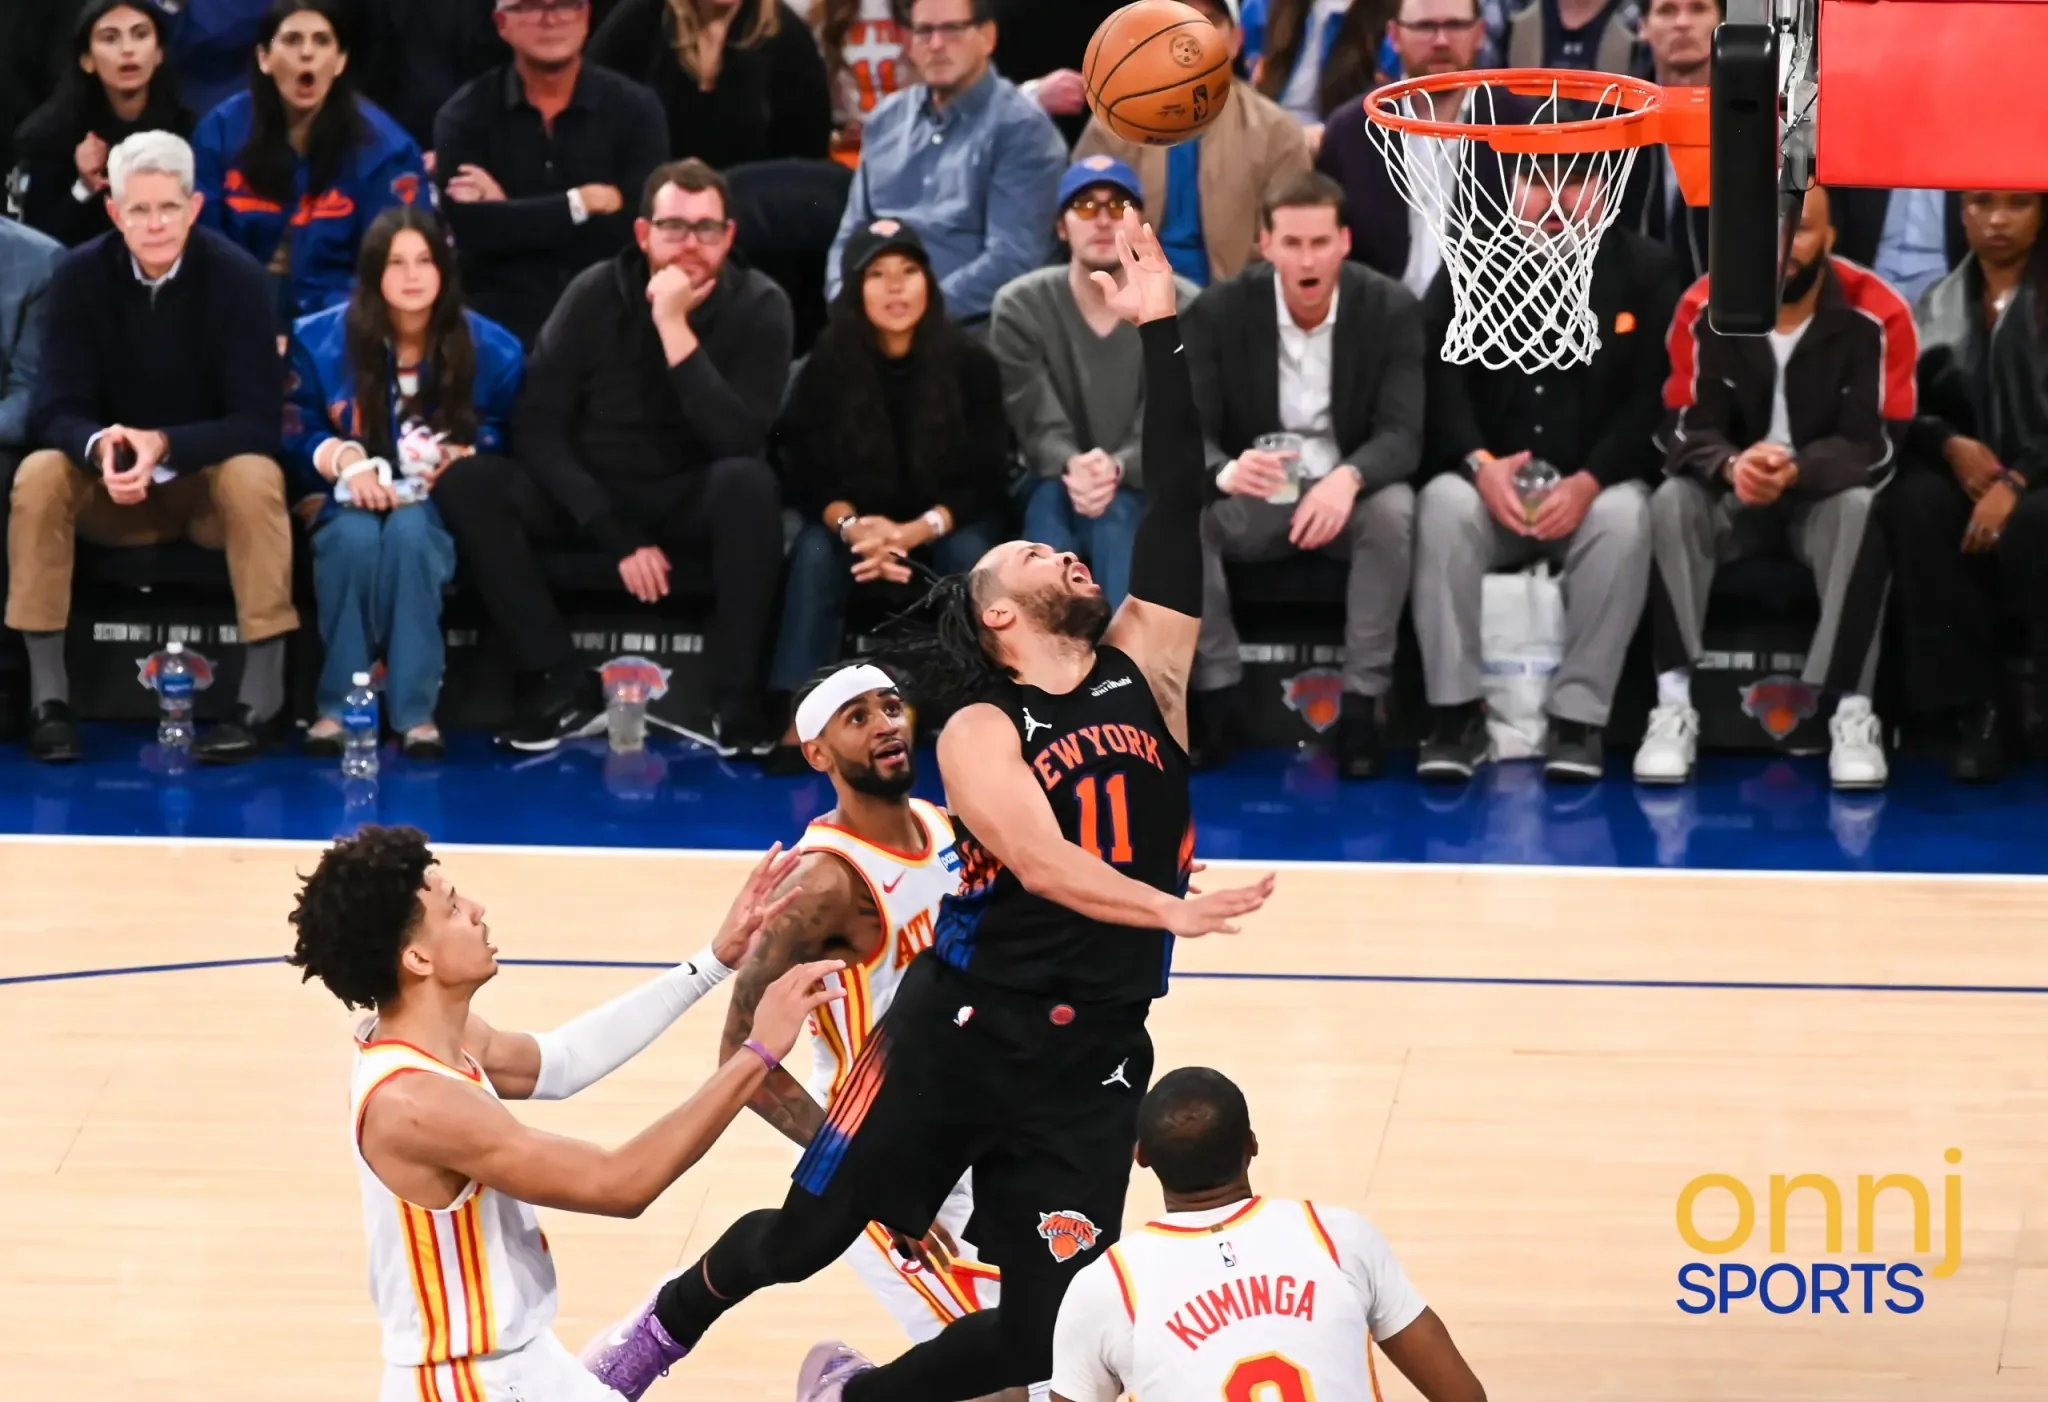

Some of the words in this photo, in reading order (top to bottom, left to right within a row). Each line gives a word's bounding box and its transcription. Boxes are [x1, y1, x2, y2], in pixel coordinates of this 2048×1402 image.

[1029, 731, 1085, 791] EW
[1078, 723, 1164, 773] YORK
[1074, 771, 1134, 863] 11
[1165, 1274, 1316, 1351] KUMINGA
